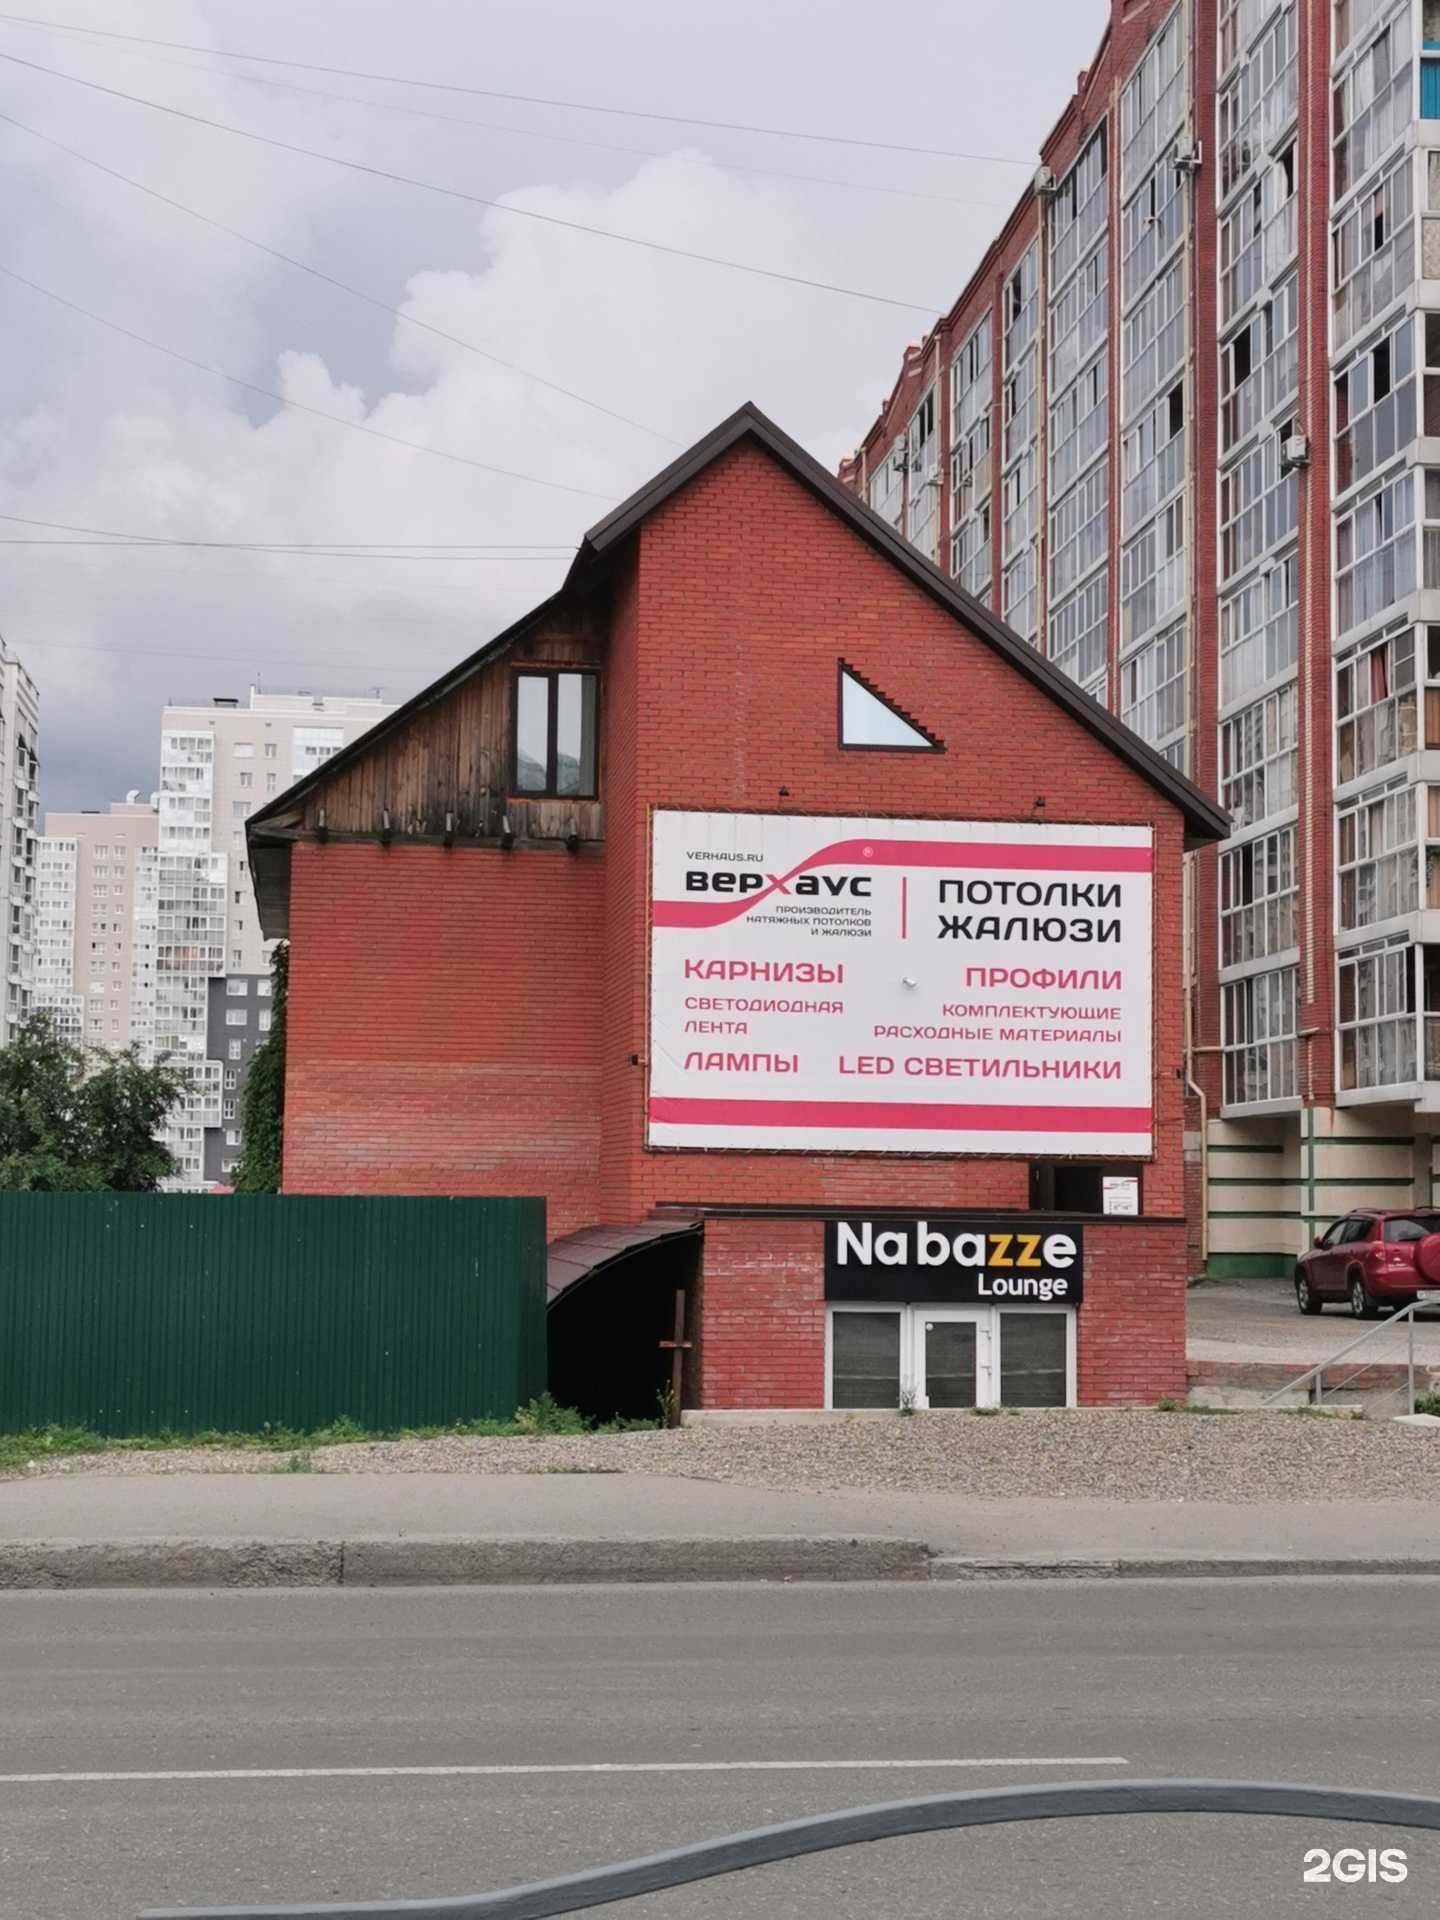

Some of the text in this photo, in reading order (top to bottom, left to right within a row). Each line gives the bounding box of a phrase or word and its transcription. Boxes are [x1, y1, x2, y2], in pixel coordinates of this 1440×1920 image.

[686, 851, 764, 863] VERHAUS.RU
[938, 880, 1122, 908] ПОТОЛКИ
[775, 905, 872, 916] ПРОИЗВОДИТЕЛЬ
[746, 915, 872, 927] НАТЯЖНЫХ ПОТОЛКОВ
[937, 915, 1122, 943] ЖАЛЮЗИ
[810, 927, 872, 937] И ЖАЛЮЗИ
[684, 959, 844, 984] КАРНИЗЫ
[965, 968, 1122, 990] ПРОФИЛИ
[684, 997, 844, 1014] СВЕТОДИОДНАЯ
[942, 1003, 1122, 1020] КОМПЛЕКТУЮЩИЕ
[684, 1020, 748, 1035] ЛЕНТА
[873, 1025, 1122, 1043] РАСХОДНЫЕ МАТЕРИАЛЫ
[683, 1051, 799, 1073] ЛАМПЫ
[839, 1055, 1122, 1080] LED СВЕТИЛЬНИКИ
[978, 1273, 1068, 1301] Lounge
